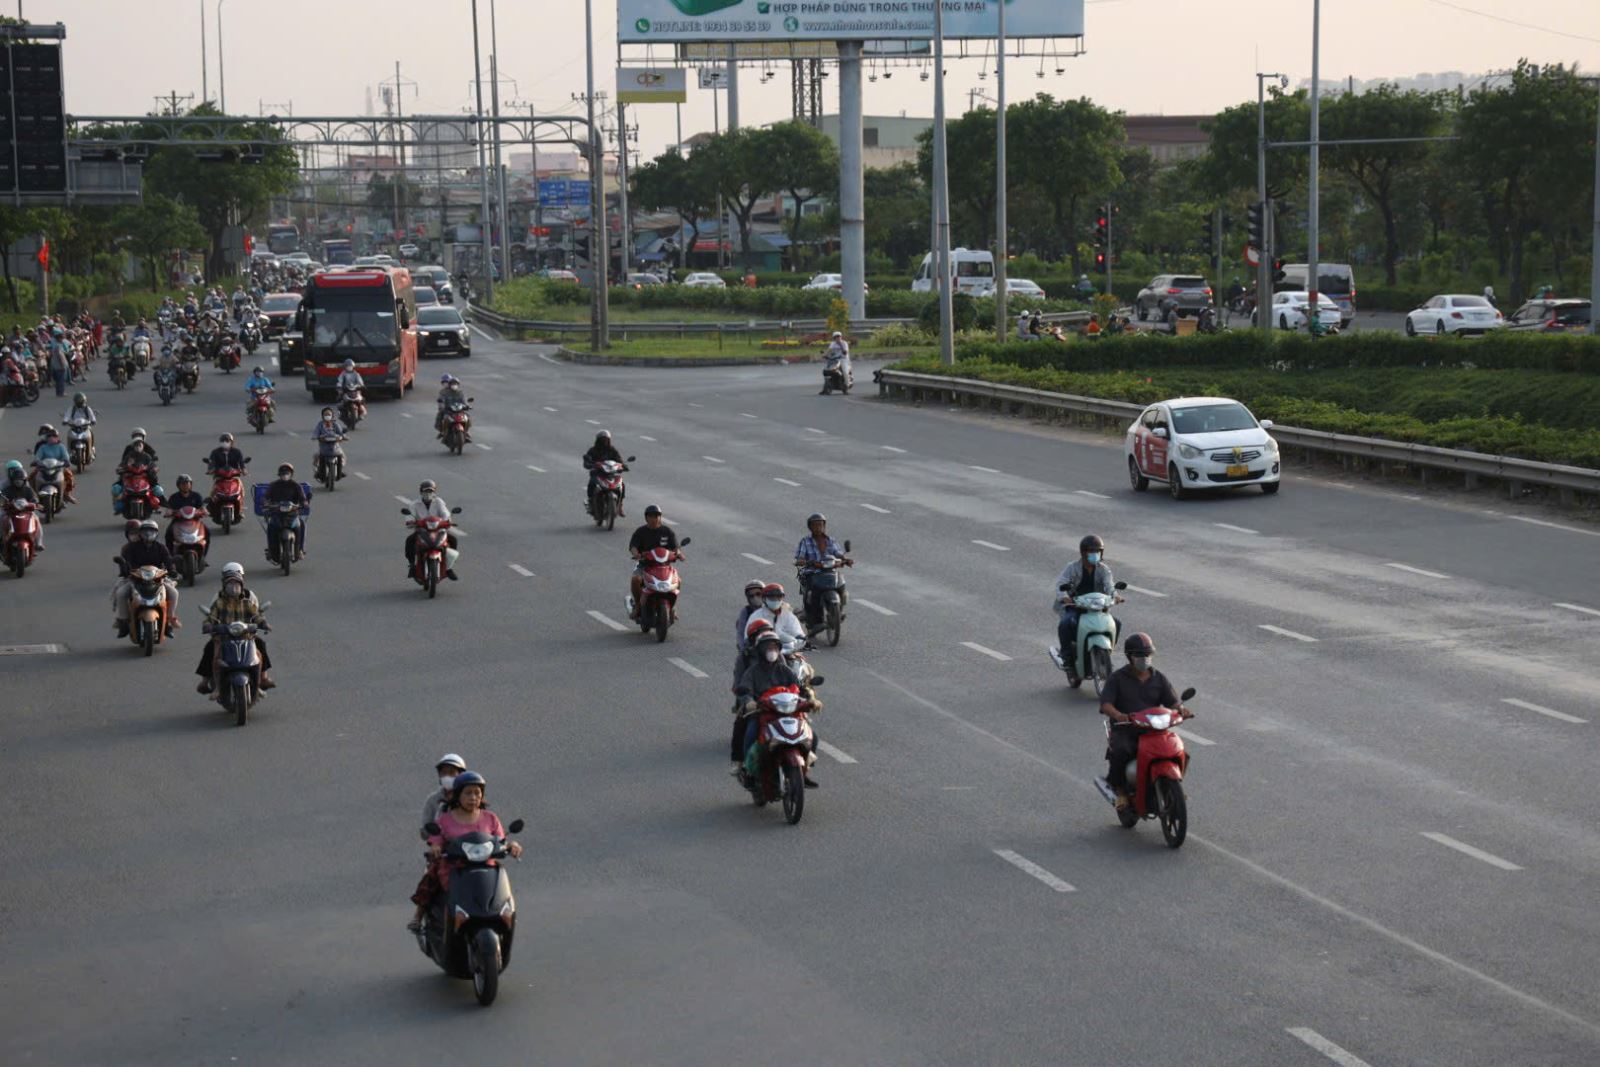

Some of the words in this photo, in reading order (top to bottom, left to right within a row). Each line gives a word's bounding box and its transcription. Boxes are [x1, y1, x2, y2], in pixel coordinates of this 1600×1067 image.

[801, 1, 831, 13] PHÁP
[833, 0, 867, 13] DÙNG
[869, 2, 908, 13] TRONG
